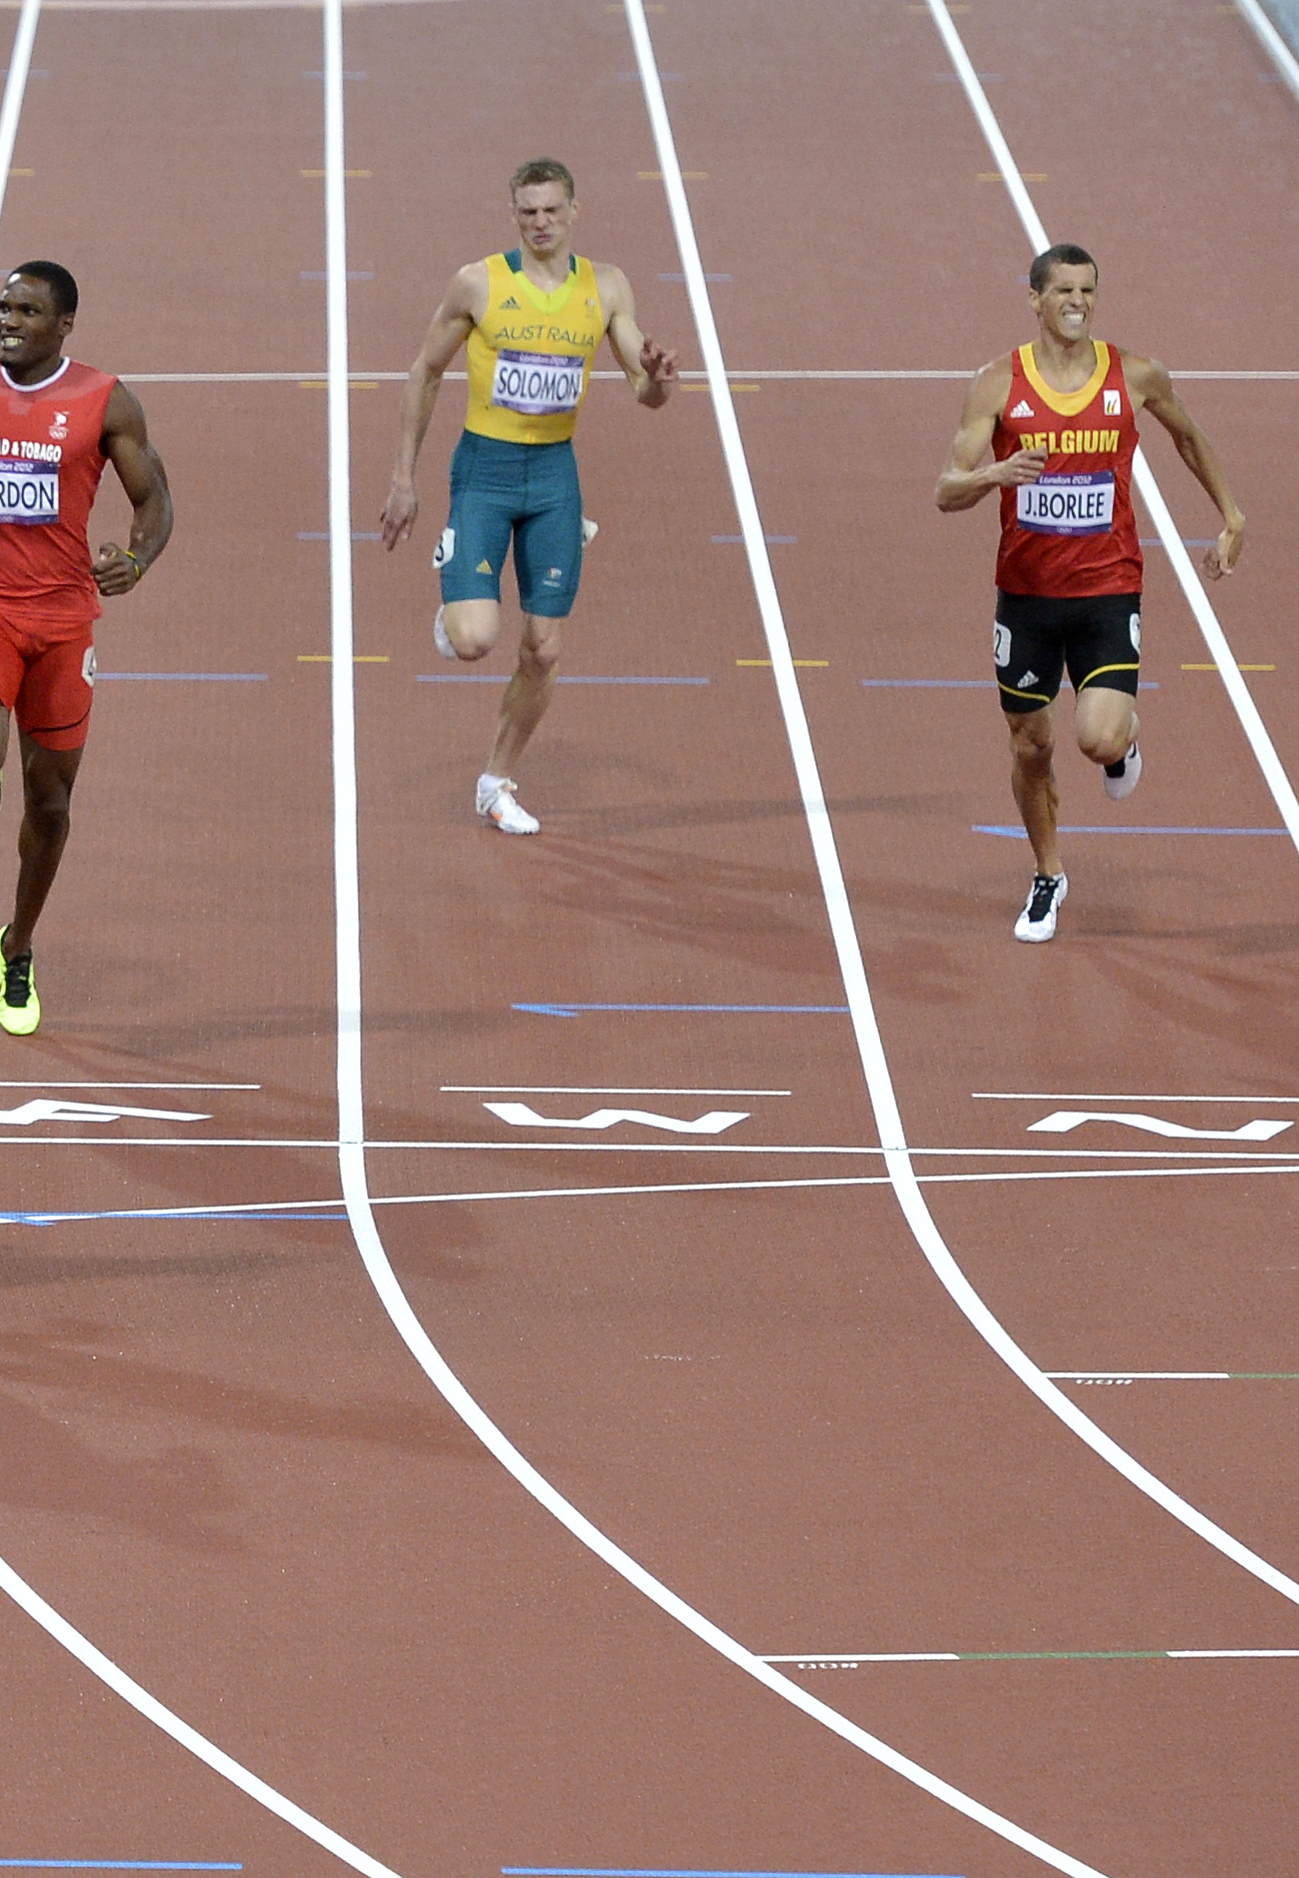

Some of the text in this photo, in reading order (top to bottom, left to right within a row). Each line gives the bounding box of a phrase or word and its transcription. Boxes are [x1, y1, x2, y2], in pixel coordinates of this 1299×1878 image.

[495, 324, 595, 347] AUSTRALIA
[497, 367, 580, 401] SOLOMON
[11, 442, 20, 456] &
[20, 440, 62, 462] TOBAGO
[1019, 429, 1120, 454] BELGIUM
[1039, 475, 1071, 485] London
[1025, 490, 1105, 519] J.BORLEE
